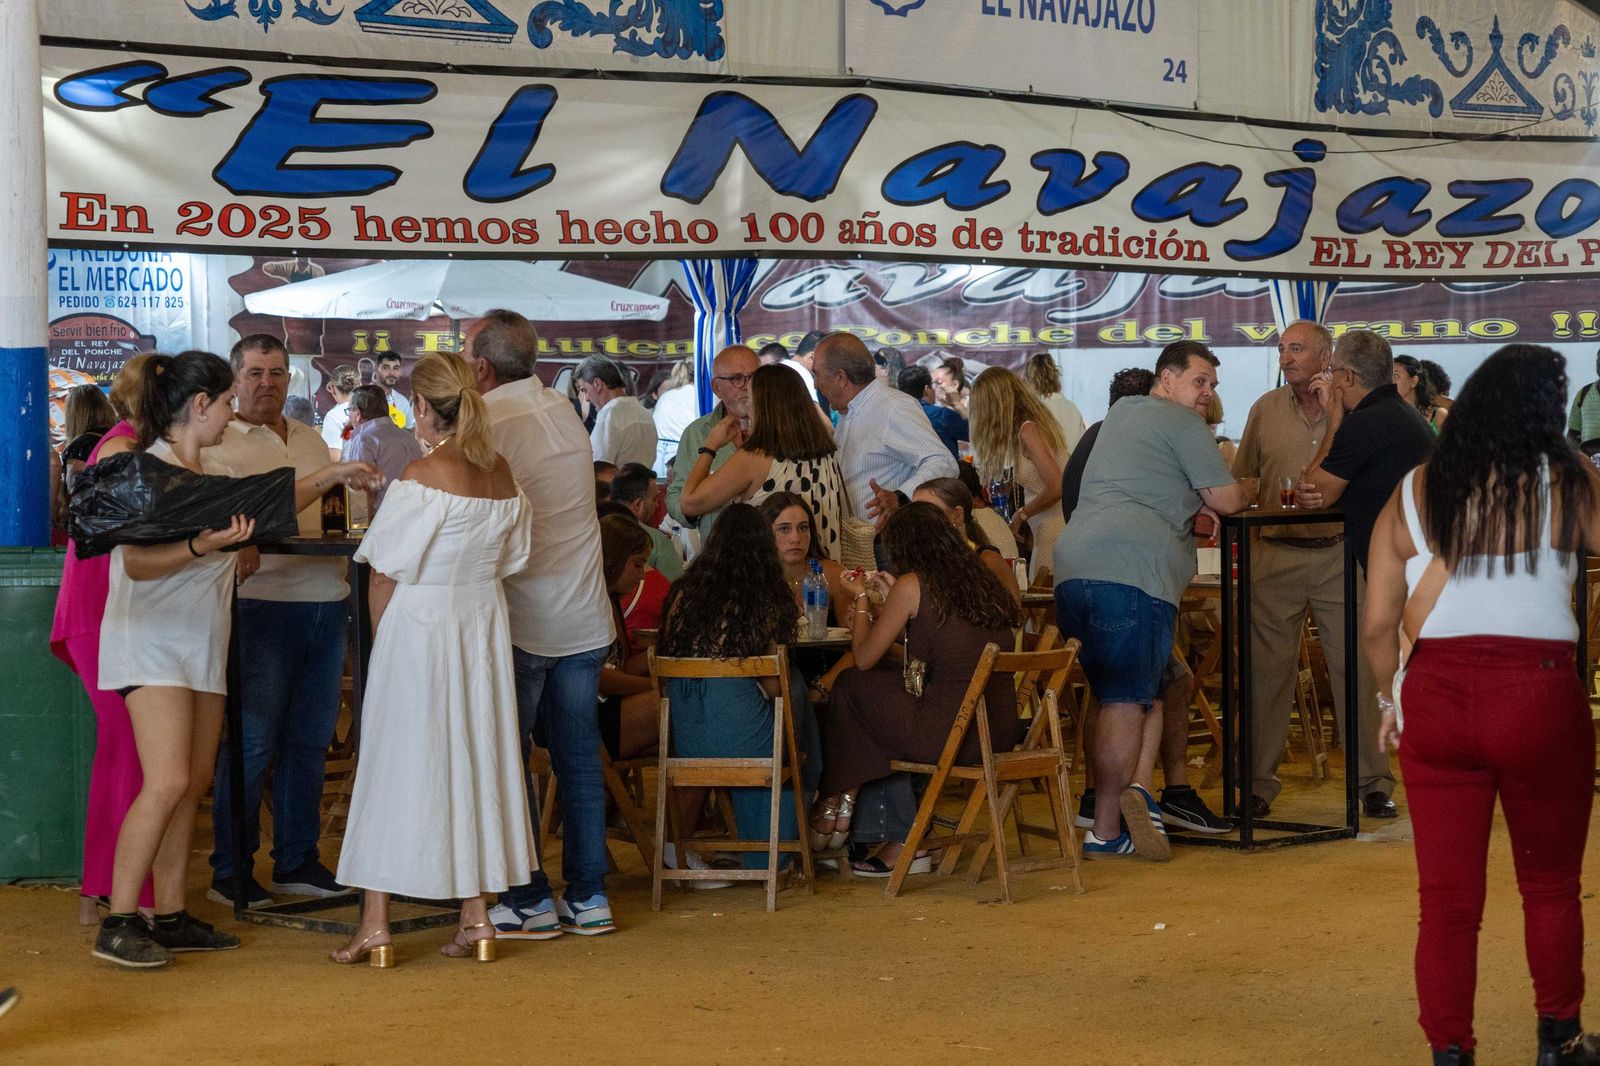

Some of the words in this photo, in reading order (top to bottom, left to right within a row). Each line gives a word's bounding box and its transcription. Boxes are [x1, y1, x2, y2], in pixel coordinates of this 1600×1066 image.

[1162, 58, 1187, 83] 24
[661, 89, 1600, 262] Navajazo
[59, 191, 154, 234] En
[176, 200, 332, 241] 2025
[351, 205, 538, 245] hemos
[556, 210, 718, 245] hecho
[740, 212, 825, 243] 100
[838, 210, 938, 248] años
[952, 218, 1004, 251] de
[1018, 222, 1210, 262] tradición
[1310, 236, 1372, 269] EL
[1382, 240, 1474, 269] REY
[1483, 239, 1569, 269] DEL
[58, 266, 81, 291] EL
[86, 266, 183, 292] MERCADO
[59, 296, 100, 308] PEDIDO
[117, 296, 137, 308] 624
[142, 297, 160, 308] 117
[165, 297, 184, 308] 825
[53, 323, 82, 337] Servir
[86, 323, 107, 337] bien
[1098, 318, 1211, 343] del
[1233, 318, 1519, 342] vrano
[76, 357, 126, 374] Navajaz
